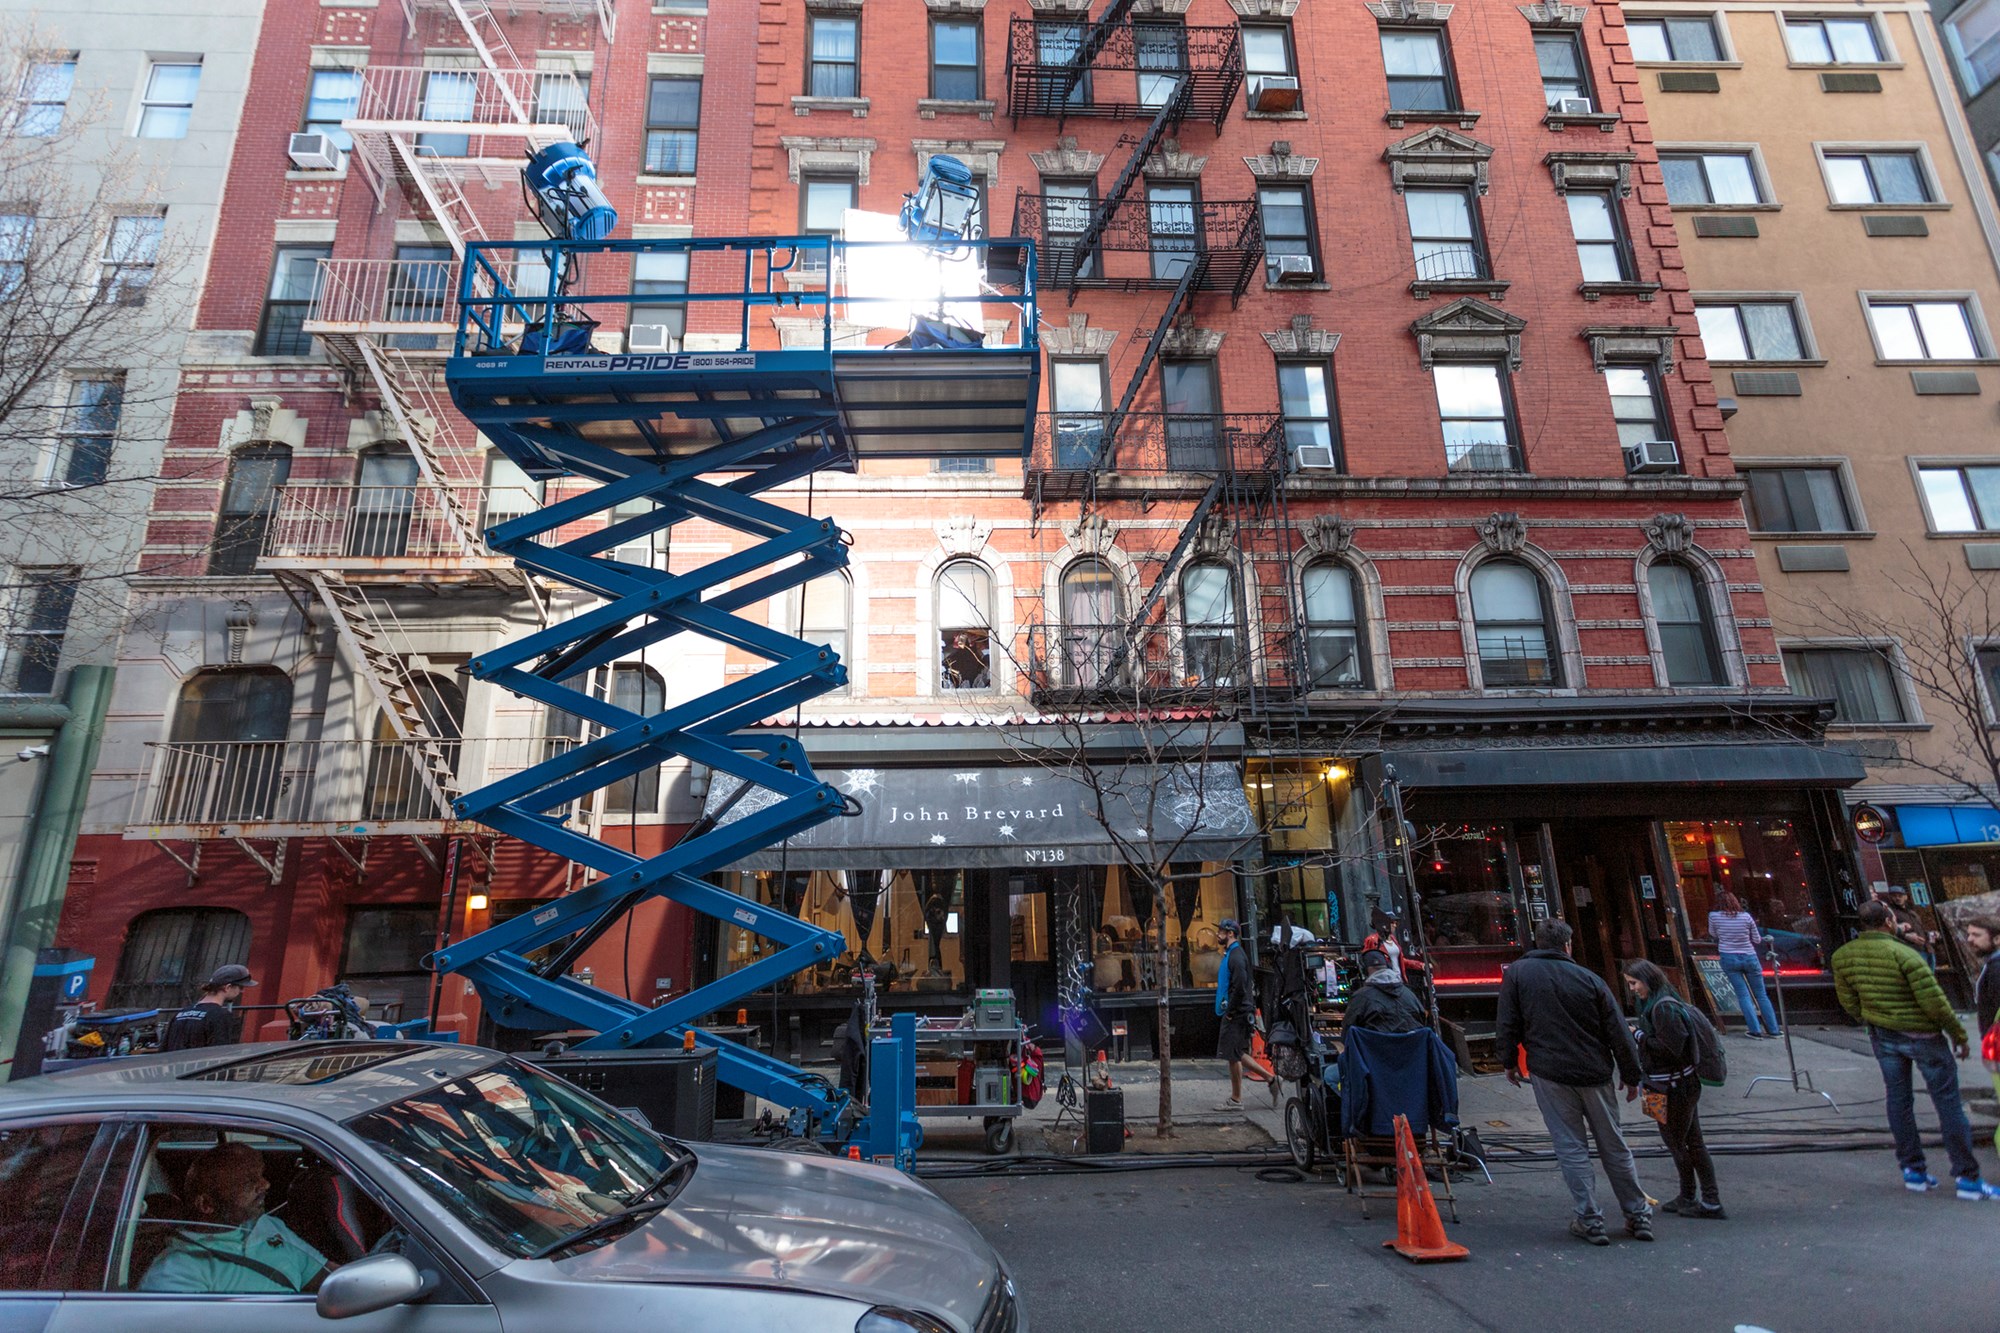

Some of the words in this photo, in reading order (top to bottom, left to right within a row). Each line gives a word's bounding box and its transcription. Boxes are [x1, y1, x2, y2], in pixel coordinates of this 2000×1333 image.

[545, 360, 608, 369] RENTALS
[609, 355, 691, 371] PRIDE
[692, 358, 713, 367] (800)
[715, 357, 754, 366] 564-PRIDE
[889, 807, 950, 824] John
[965, 803, 1064, 820] Brevard
[70, 975, 84, 994] P
